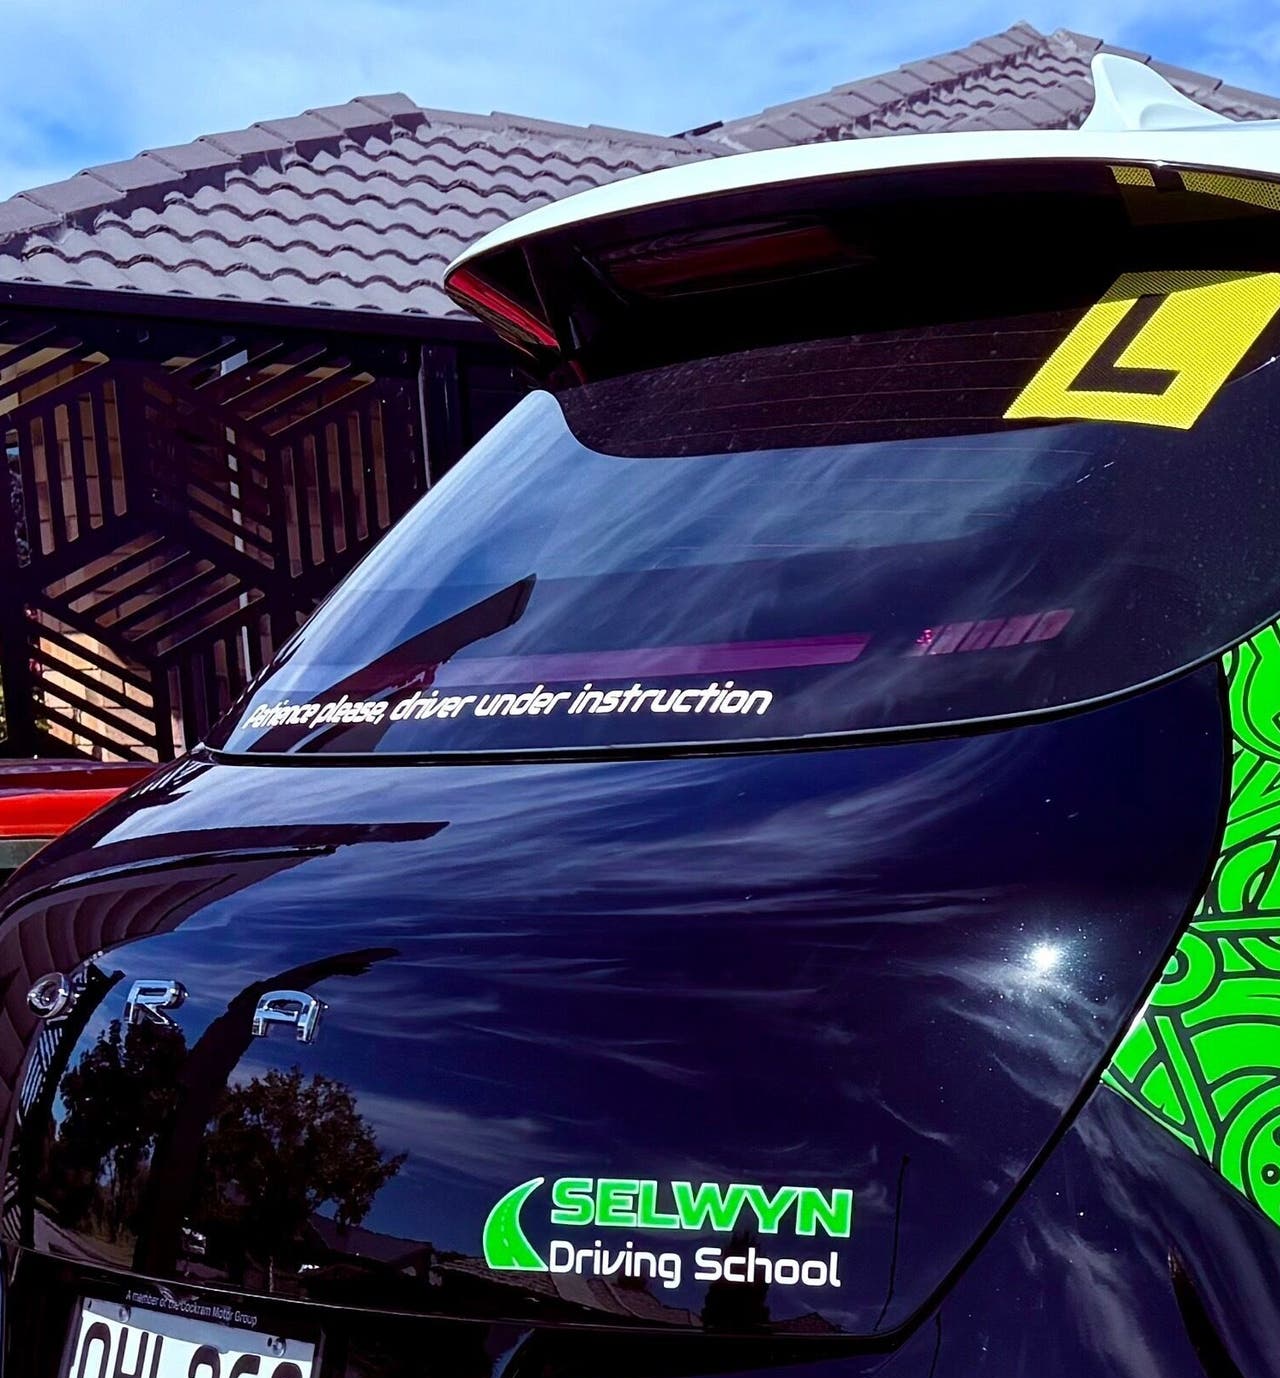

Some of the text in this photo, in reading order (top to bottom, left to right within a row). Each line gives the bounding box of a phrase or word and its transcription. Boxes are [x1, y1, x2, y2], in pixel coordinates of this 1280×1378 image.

[1066, 294, 1181, 396] L
[309, 694, 389, 729] please,
[390, 690, 478, 720] driver
[474, 684, 572, 716] under
[567, 680, 773, 715] instruction
[27, 971, 323, 1044] ORA
[551, 1177, 853, 1238] SELWYN
[550, 1240, 841, 1289] Driving School
[234, 1311, 257, 1327] Group
